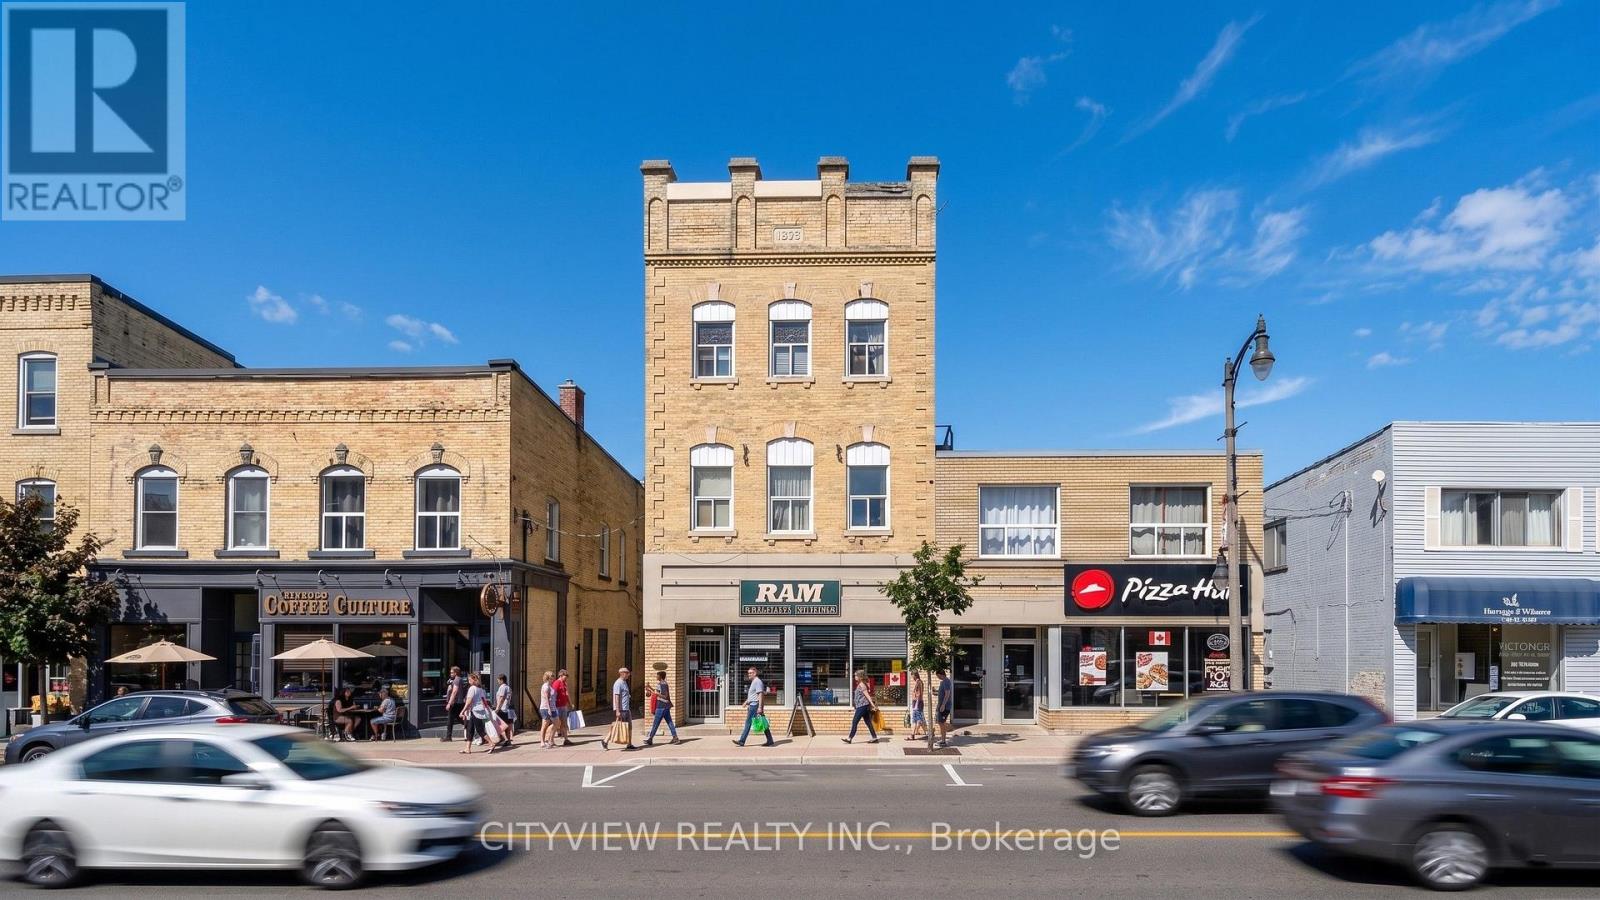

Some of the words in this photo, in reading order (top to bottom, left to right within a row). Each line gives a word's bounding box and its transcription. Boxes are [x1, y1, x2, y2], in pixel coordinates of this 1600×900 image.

[755, 583, 824, 603] RAM
[1121, 577, 1189, 603] Pizza
[1191, 577, 1243, 600] Hu
[264, 595, 329, 615] COFFEE
[333, 595, 412, 615] CULTURE
